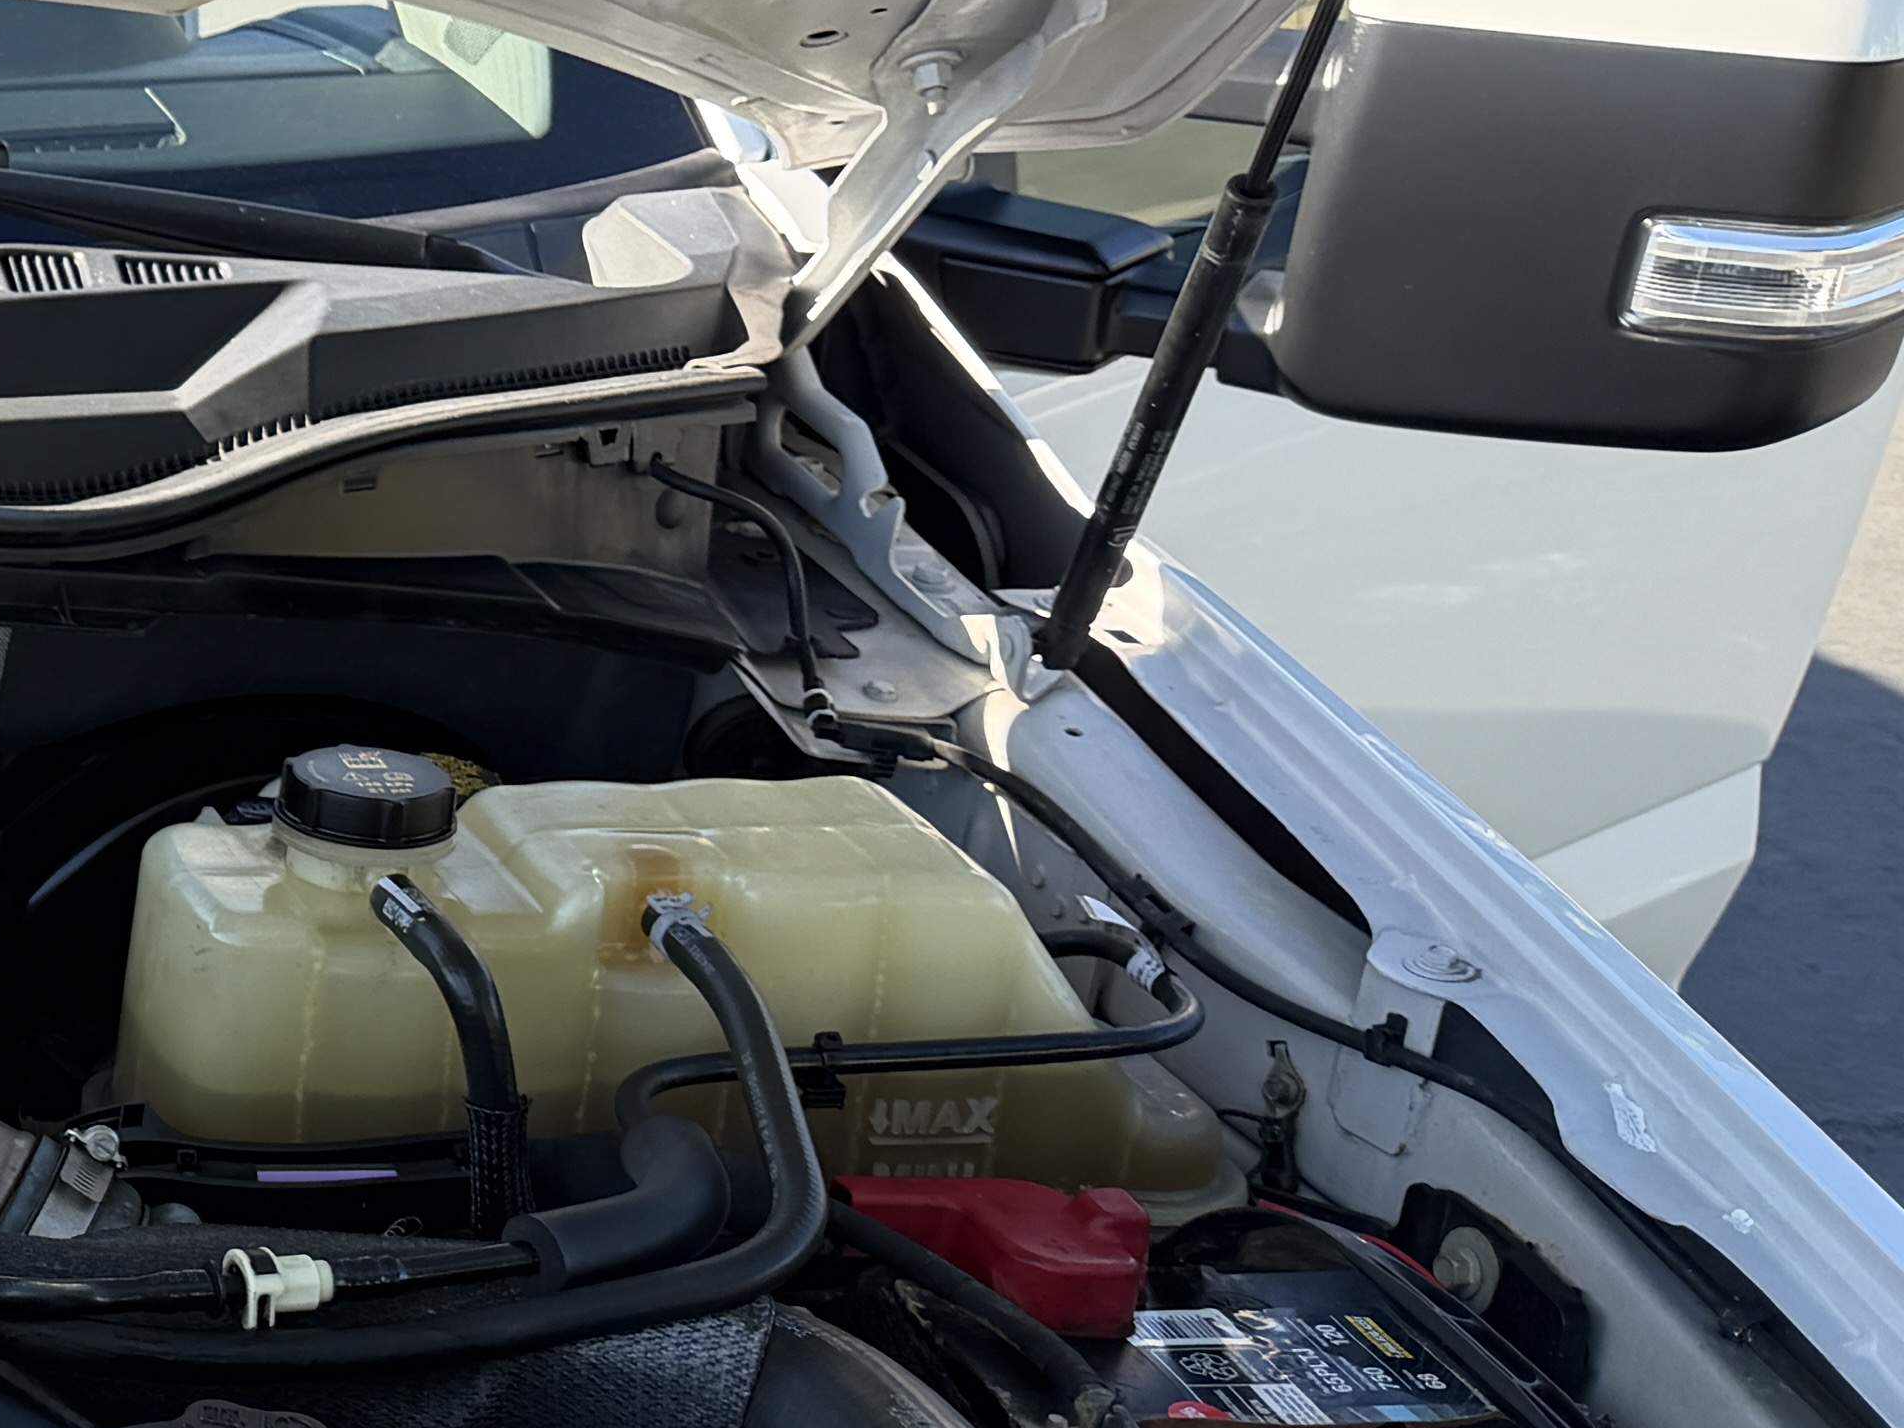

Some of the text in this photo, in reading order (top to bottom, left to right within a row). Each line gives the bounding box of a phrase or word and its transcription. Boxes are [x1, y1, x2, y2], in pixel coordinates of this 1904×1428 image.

[890, 1098, 1000, 1135] MAX
[1316, 1323, 1350, 1346] 120
[1362, 1366, 1400, 1390] 750
